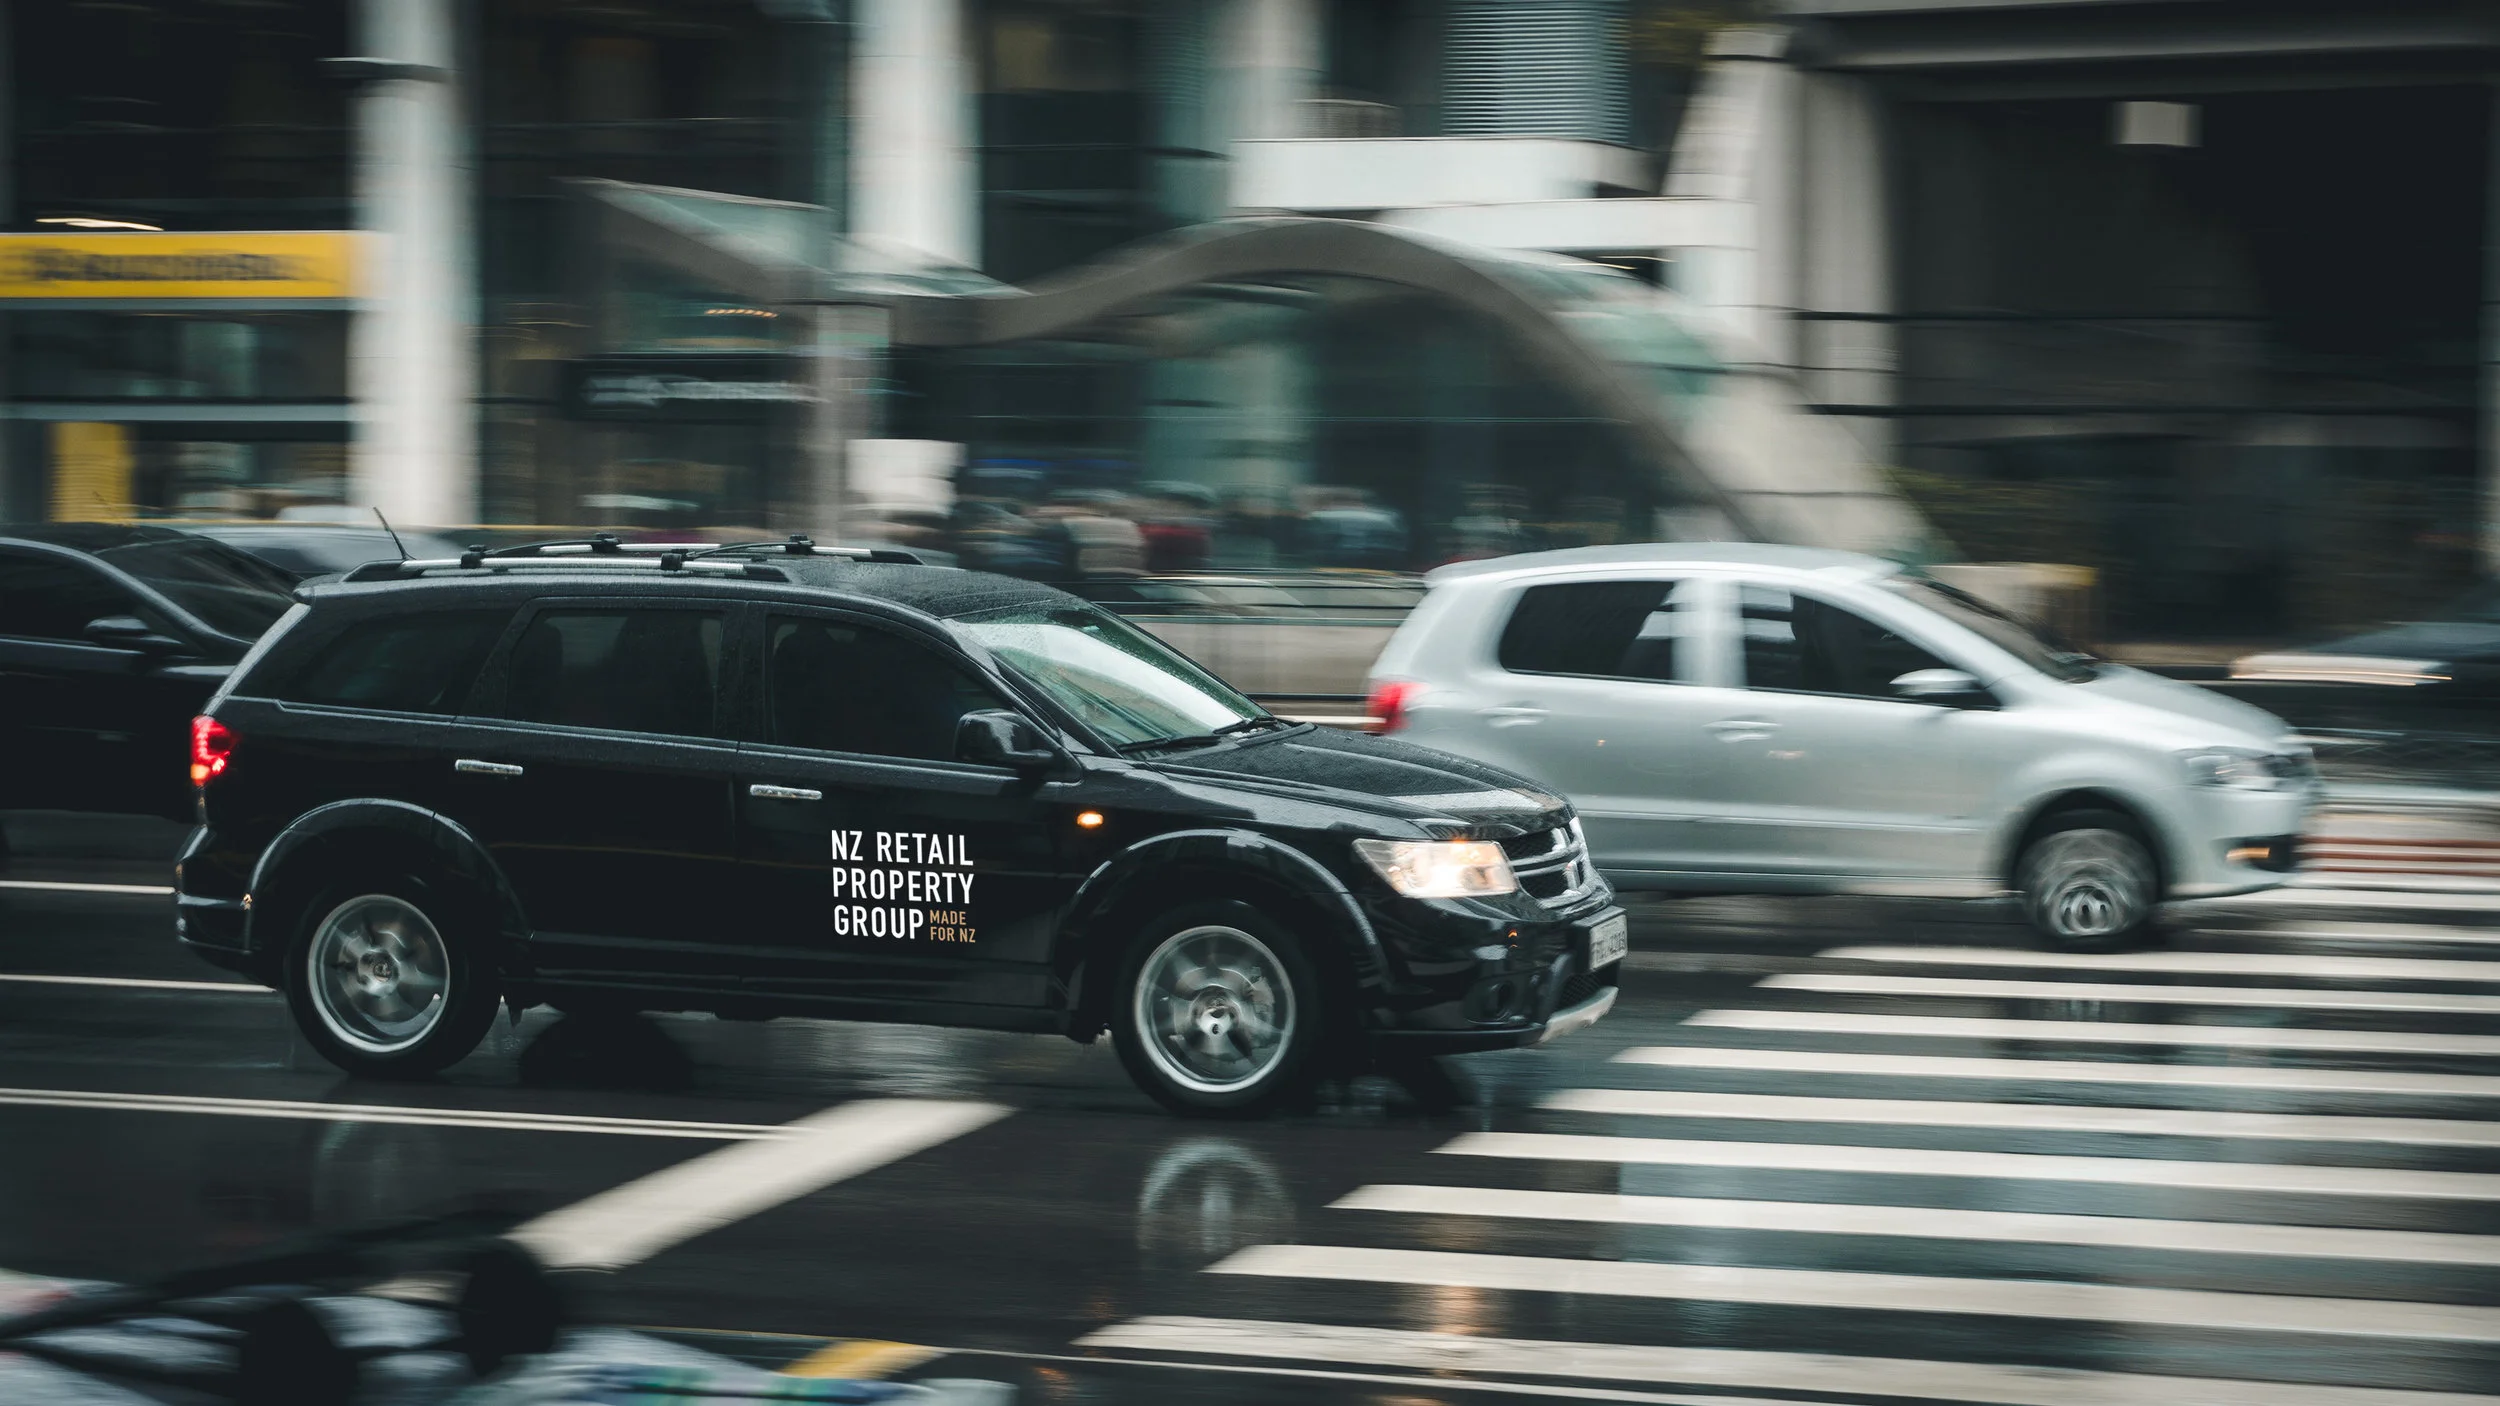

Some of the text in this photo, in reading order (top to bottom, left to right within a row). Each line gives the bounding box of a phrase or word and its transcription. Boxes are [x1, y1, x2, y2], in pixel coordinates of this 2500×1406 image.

[831, 829, 974, 867] NZ RETAIL
[832, 866, 975, 905] PROPERTY
[833, 904, 924, 940] GROUP
[930, 909, 967, 926] MADE
[930, 926, 976, 944] FOR NZ
